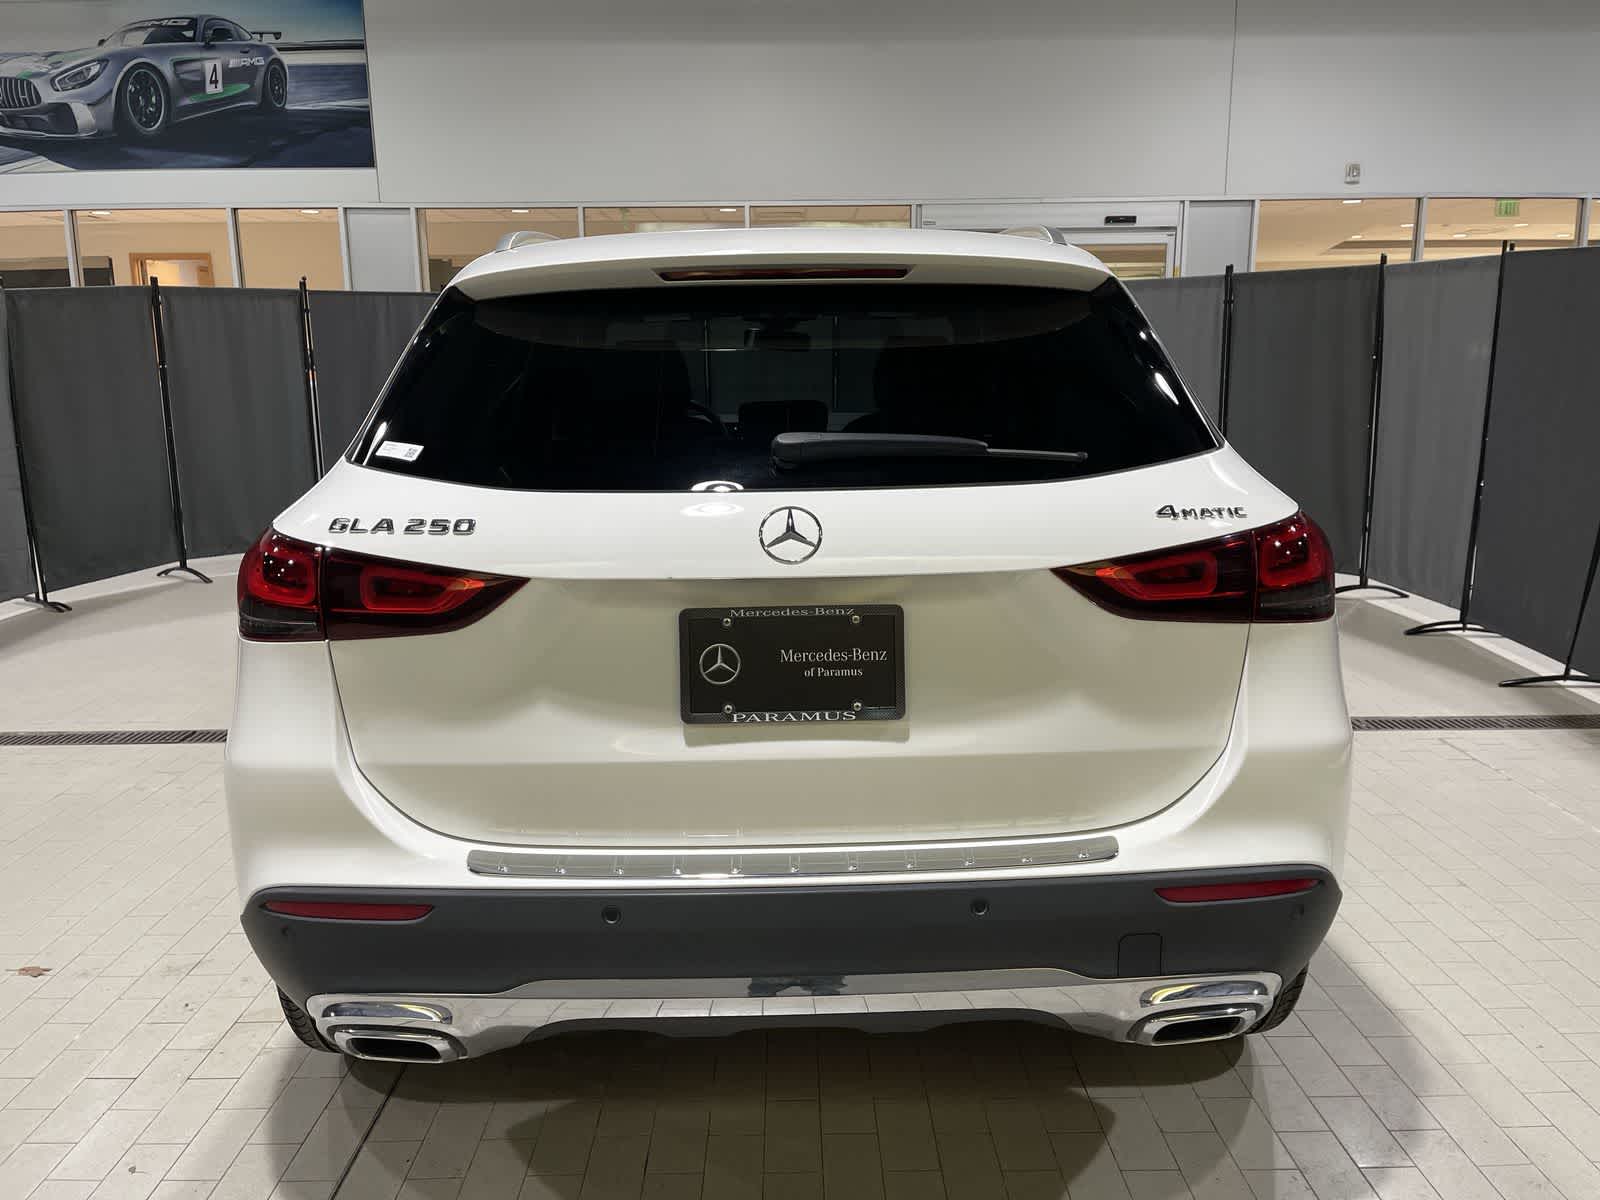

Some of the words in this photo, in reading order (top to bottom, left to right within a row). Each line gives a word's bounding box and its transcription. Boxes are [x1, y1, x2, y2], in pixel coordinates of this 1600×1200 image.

[209, 63, 219, 89] 4
[1155, 504, 1248, 520] 4MATIC
[328, 517, 395, 535] GLA
[403, 518, 477, 536] 250
[730, 607, 855, 618] Mercedes-Benz
[779, 648, 888, 663] Mercedes-Benz
[804, 667, 816, 677] of
[817, 667, 864, 678] Paramus
[731, 711, 857, 723] PARAMUS
